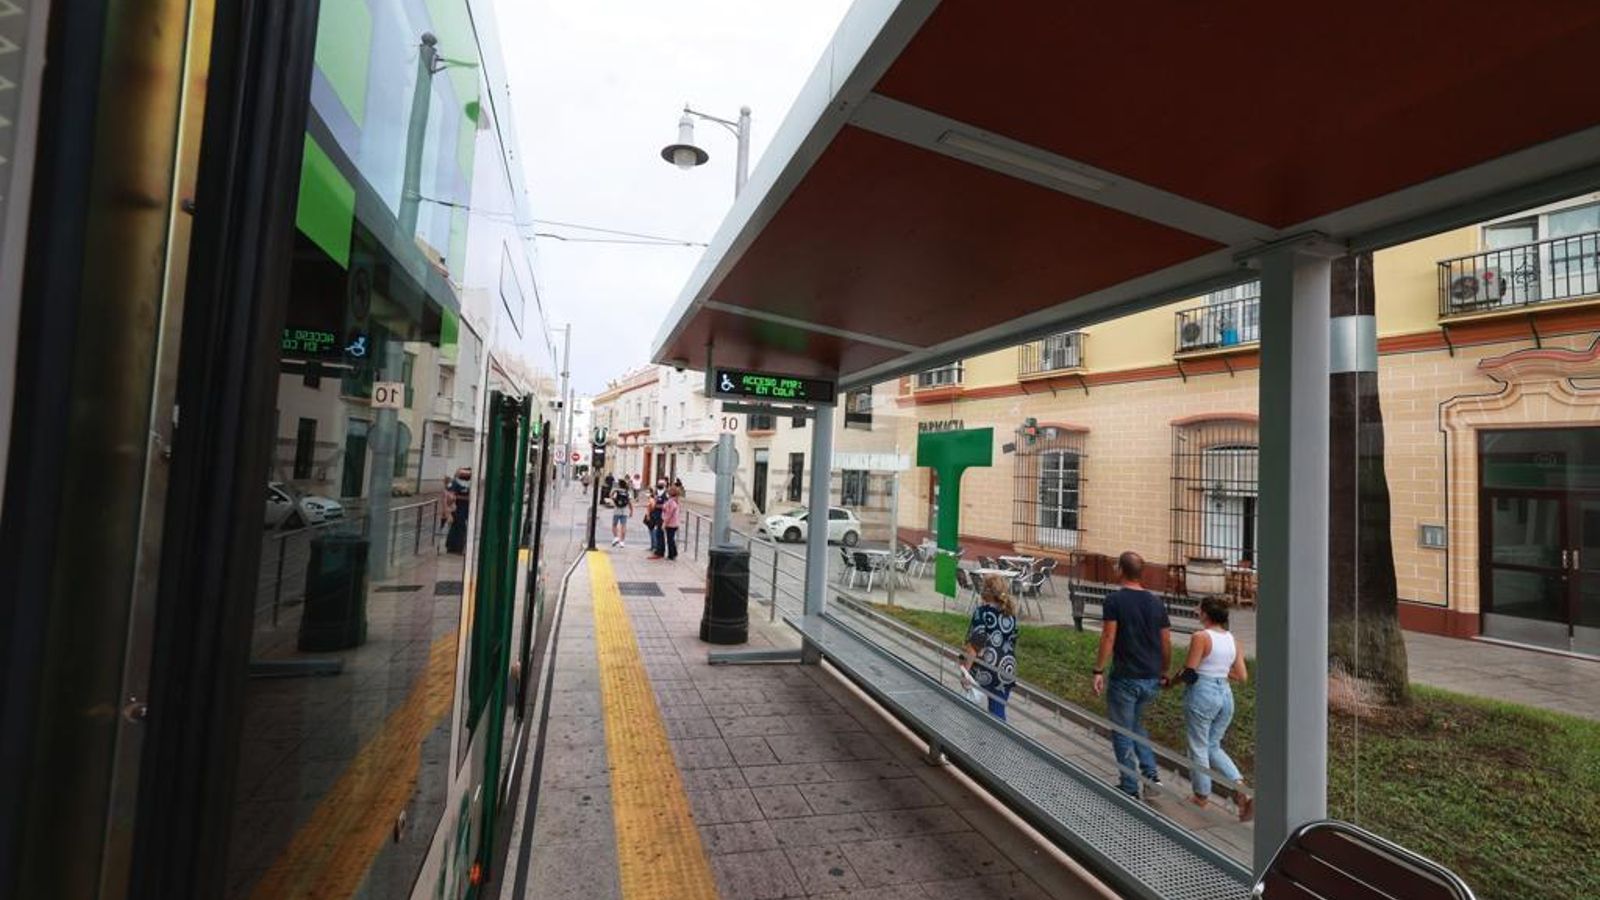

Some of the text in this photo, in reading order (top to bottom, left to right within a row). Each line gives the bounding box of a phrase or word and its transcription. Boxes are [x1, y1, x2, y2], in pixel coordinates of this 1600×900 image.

[743, 375, 777, 387] ACCESO
[756, 386, 768, 394] EN
[772, 387, 795, 397] COLA
[721, 417, 739, 430] 10
